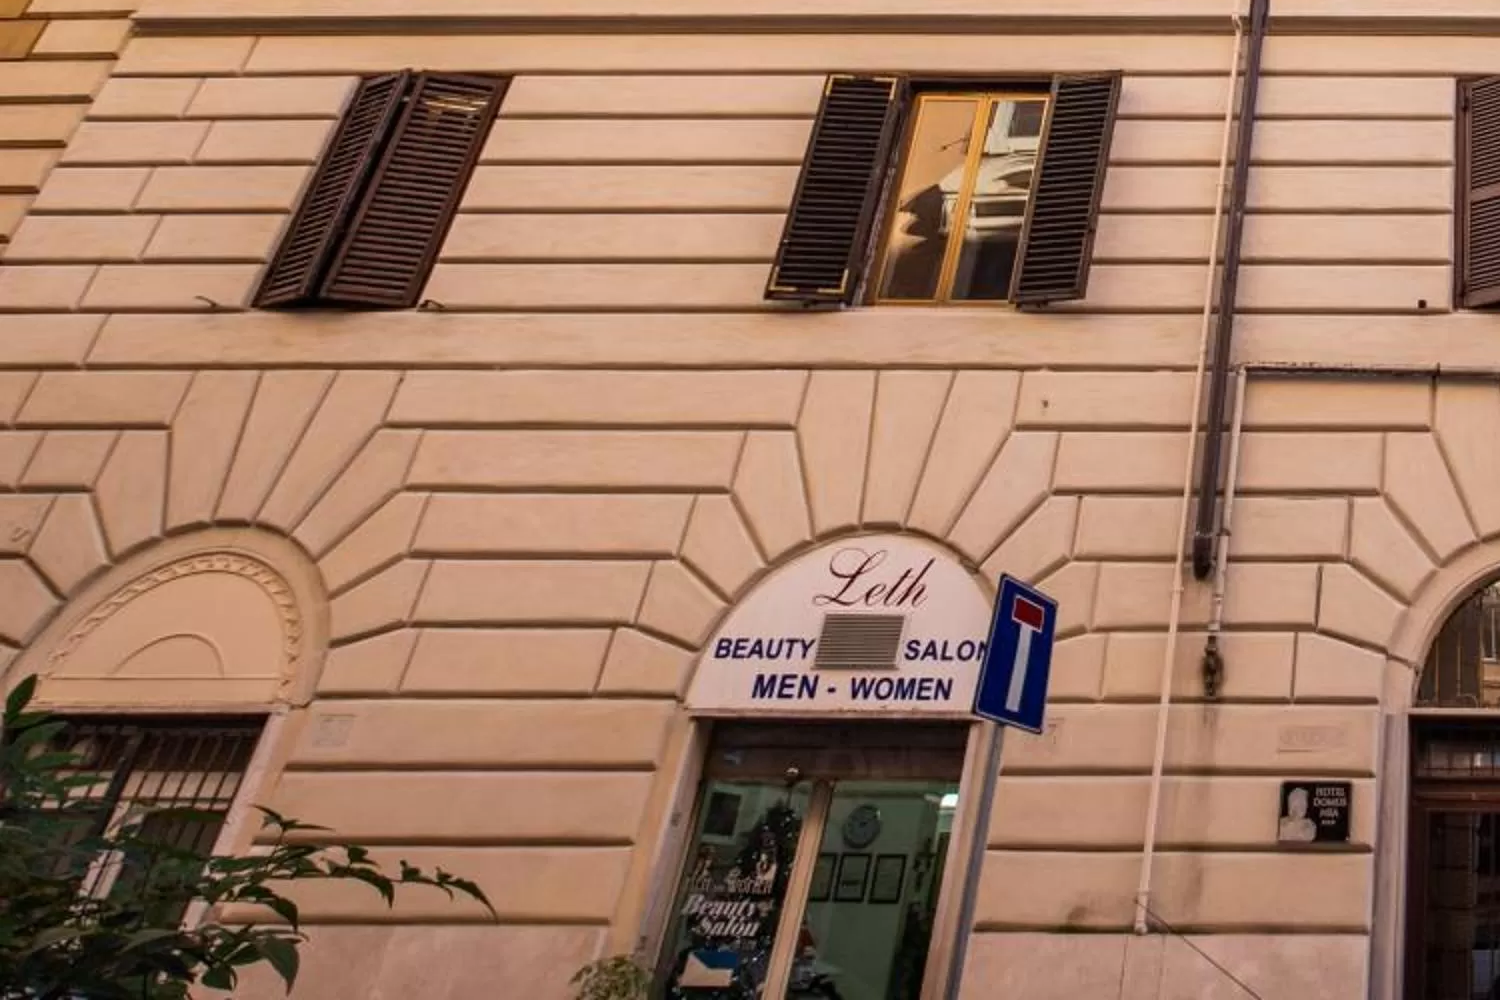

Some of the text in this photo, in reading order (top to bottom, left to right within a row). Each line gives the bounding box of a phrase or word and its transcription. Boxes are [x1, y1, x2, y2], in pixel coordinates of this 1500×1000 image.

[812, 547, 935, 607] Leth
[714, 637, 816, 659] BEAUTY
[751, 674, 820, 699] MEN
[850, 677, 953, 701] WOMEN
